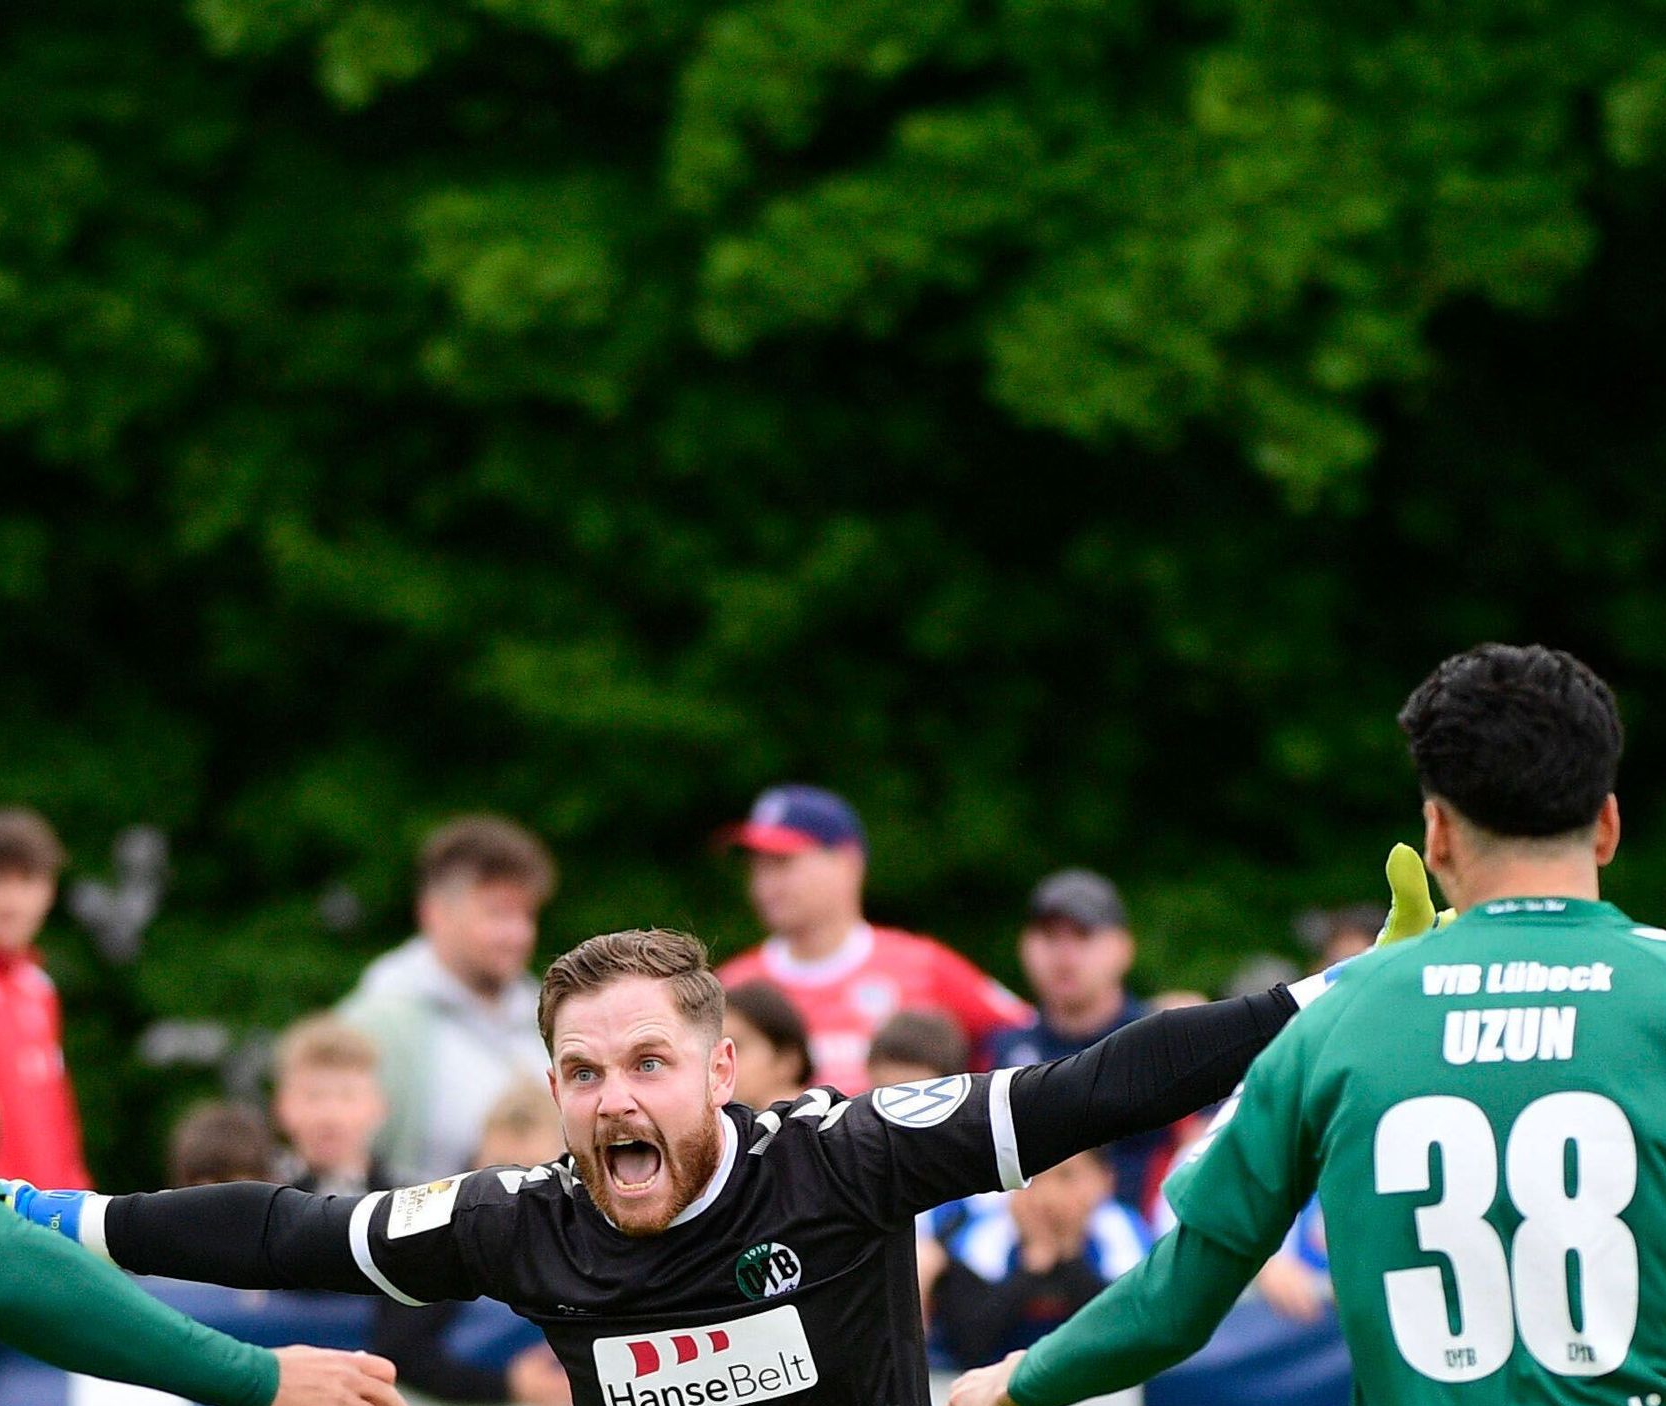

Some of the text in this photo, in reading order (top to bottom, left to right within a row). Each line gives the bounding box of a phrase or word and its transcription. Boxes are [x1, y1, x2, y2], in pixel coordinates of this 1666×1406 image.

[1422, 961, 1614, 996] VfB Lübeck
[1443, 1006, 1578, 1065] UZUN
[744, 1244, 769, 1260] 1919
[1374, 1091, 1639, 1384] 38
